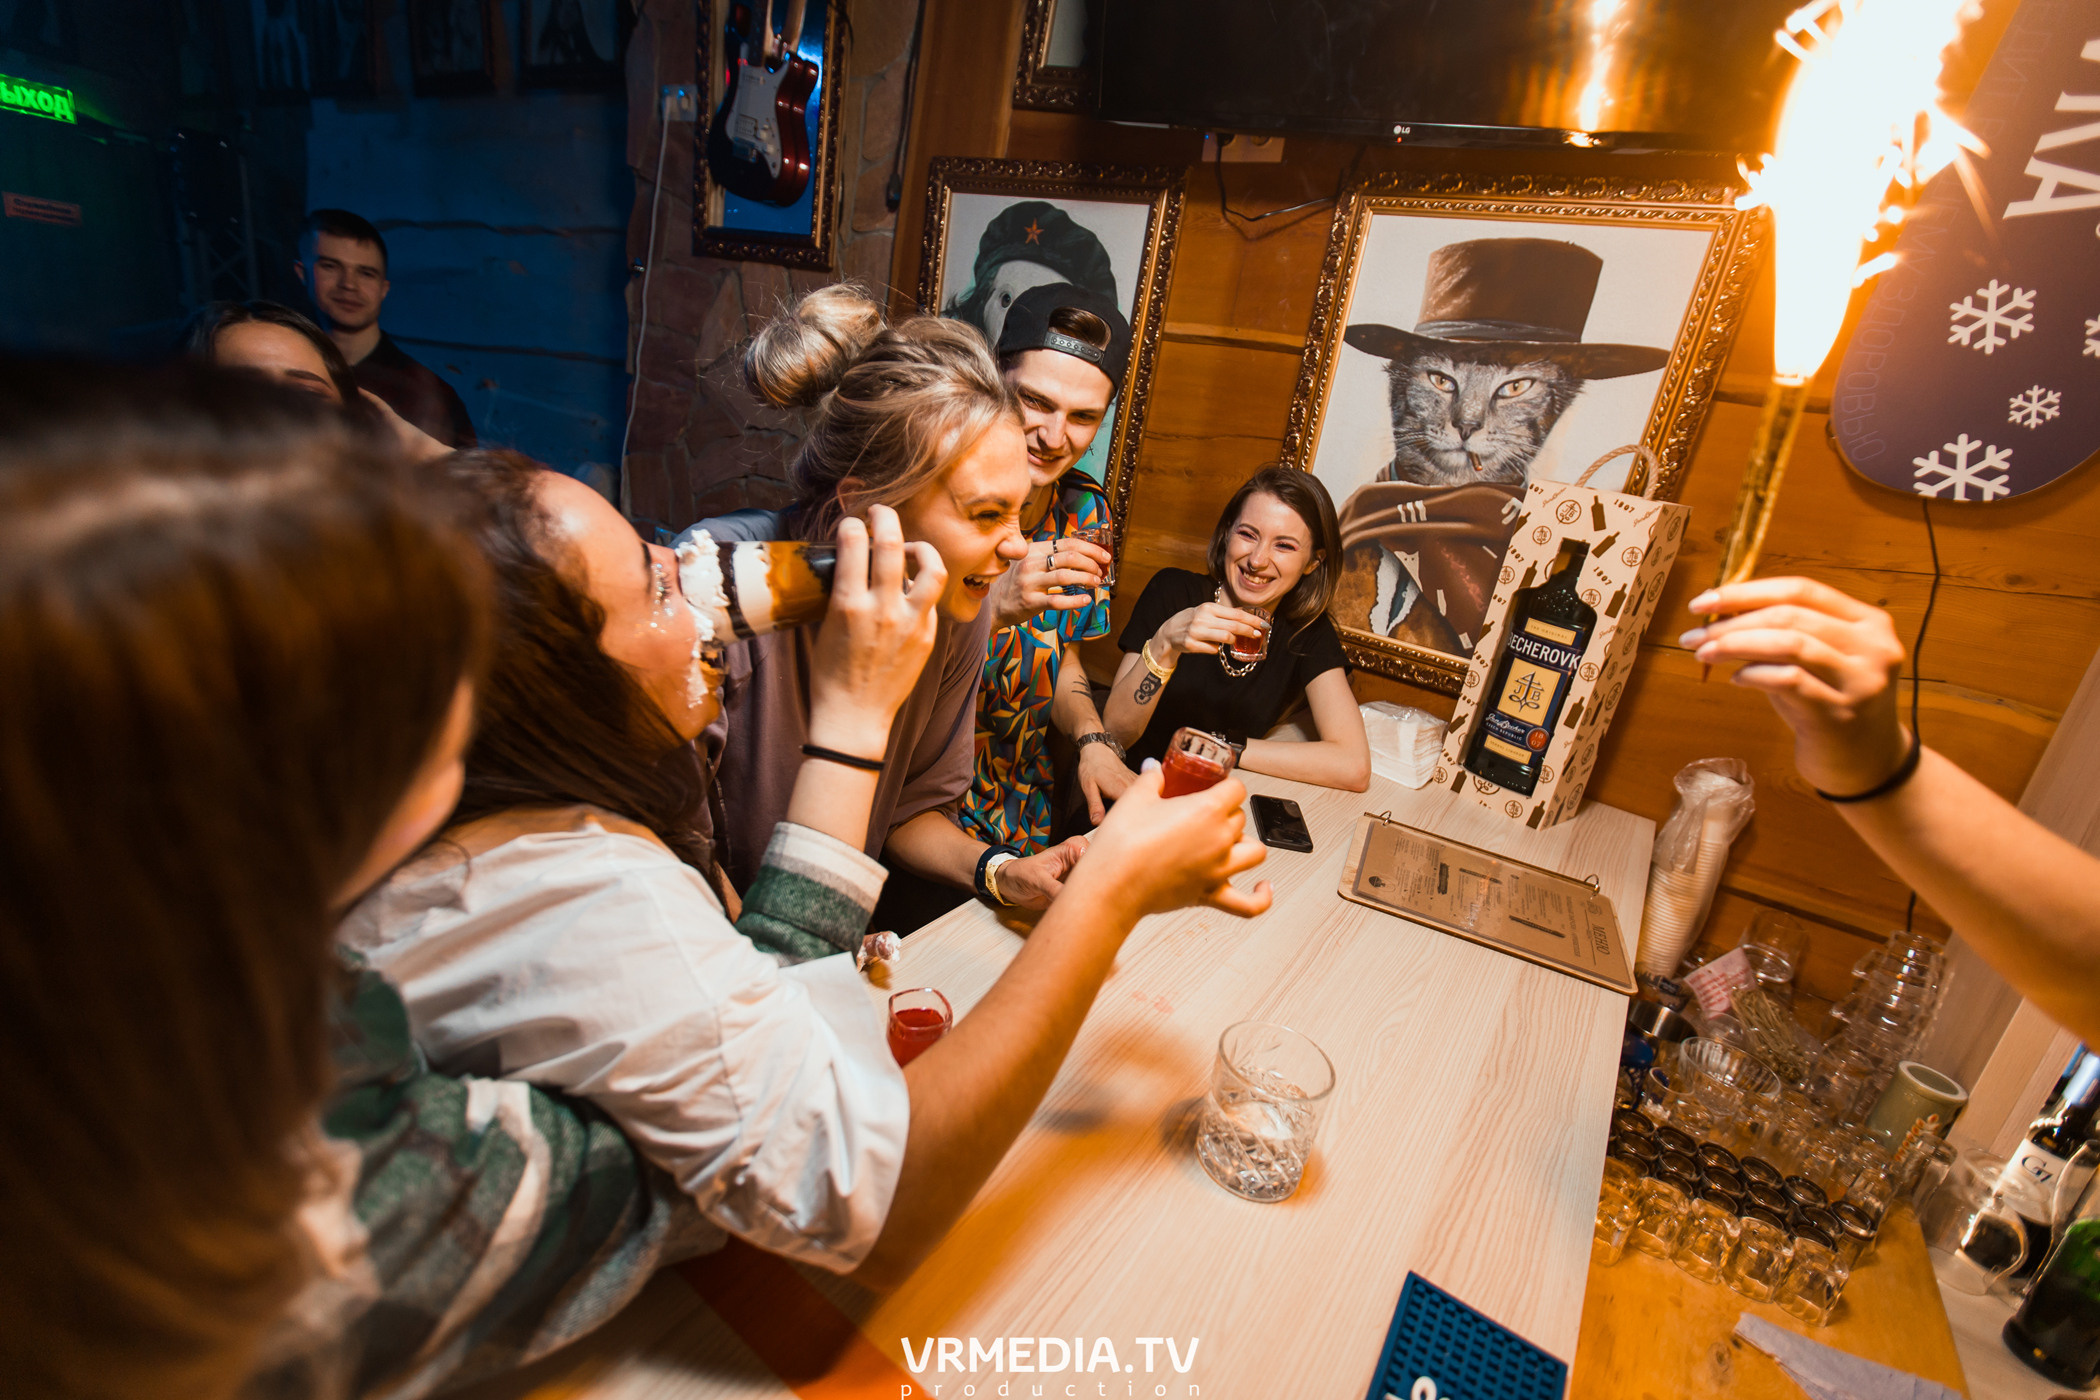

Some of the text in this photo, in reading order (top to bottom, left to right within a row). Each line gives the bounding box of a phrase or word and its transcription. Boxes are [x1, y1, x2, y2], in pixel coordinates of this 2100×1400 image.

[0, 81, 75, 123] ЫХОД
[1839, 279, 1918, 463] ЗДОРОВЬЮ
[1613, 499, 1635, 514] 1807
[1593, 566, 1613, 586] 1807
[1441, 748, 1456, 766] 1807
[1592, 923, 1610, 955] МЕНЮ
